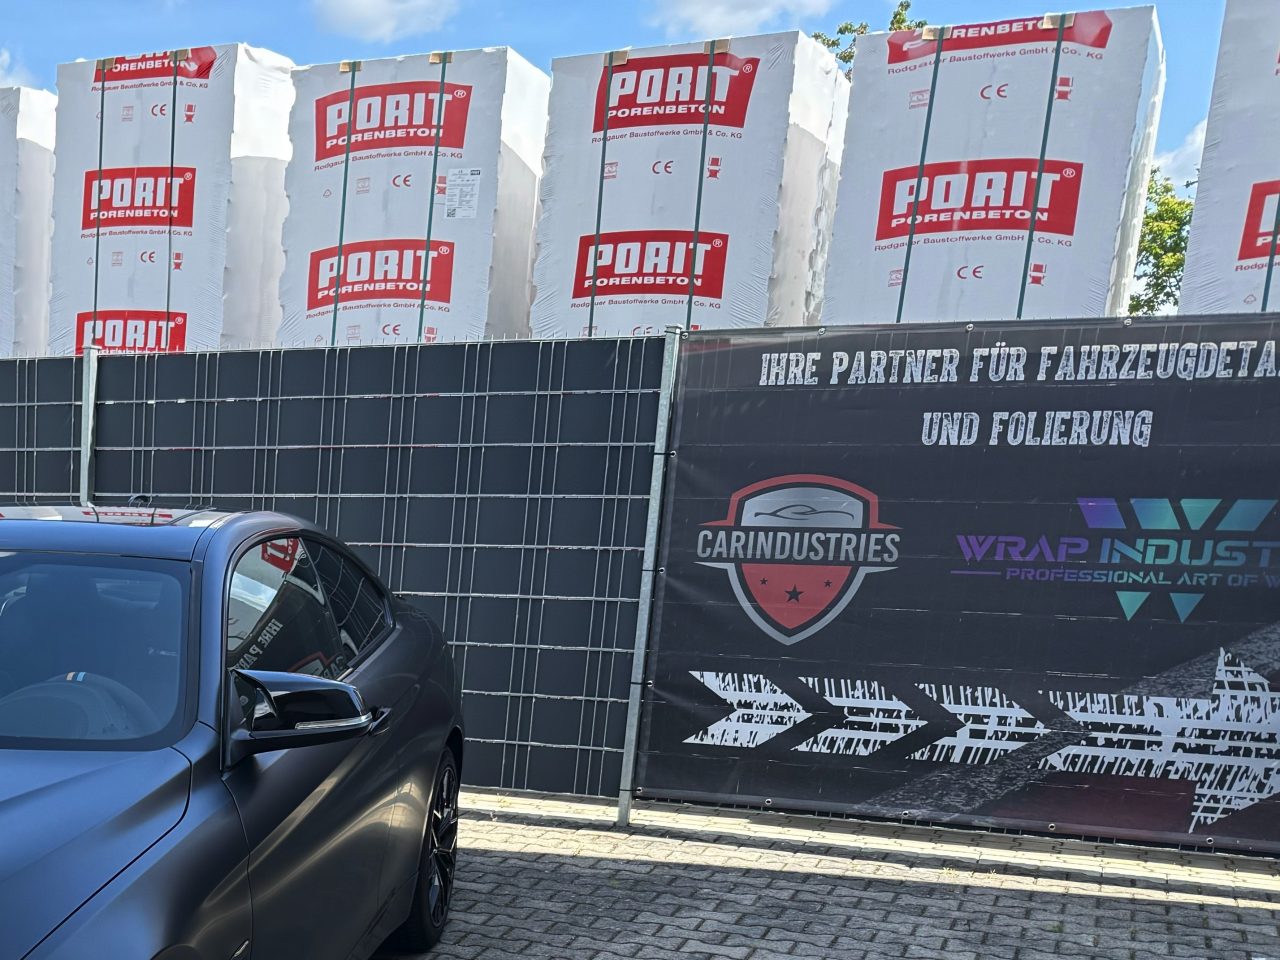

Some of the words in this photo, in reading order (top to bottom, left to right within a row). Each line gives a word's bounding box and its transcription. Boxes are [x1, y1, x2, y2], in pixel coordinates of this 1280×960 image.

[949, 50, 1017, 63] Baustoffwerke
[1019, 47, 1049, 56] GmbH
[1086, 51, 1103, 60] KG
[607, 104, 725, 119] PORENBETON
[890, 208, 1048, 228] PORENBETON
[1038, 236, 1054, 244] Co.
[1057, 239, 1072, 247] KG
[759, 351, 821, 386] IHRE
[829, 348, 959, 385] PARTNER
[970, 341, 1027, 383] FÜR
[1037, 340, 1280, 382] FAHRZEUGDETA
[920, 410, 980, 447] UND
[988, 409, 1154, 448] FOLIERUNG
[696, 529, 901, 564] CARINDUSTRIES
[955, 533, 1089, 562] WRAP
[1005, 566, 1172, 585] PROFESSIONAL
[1176, 571, 1223, 586] ART
[1227, 573, 1259, 588] OF
